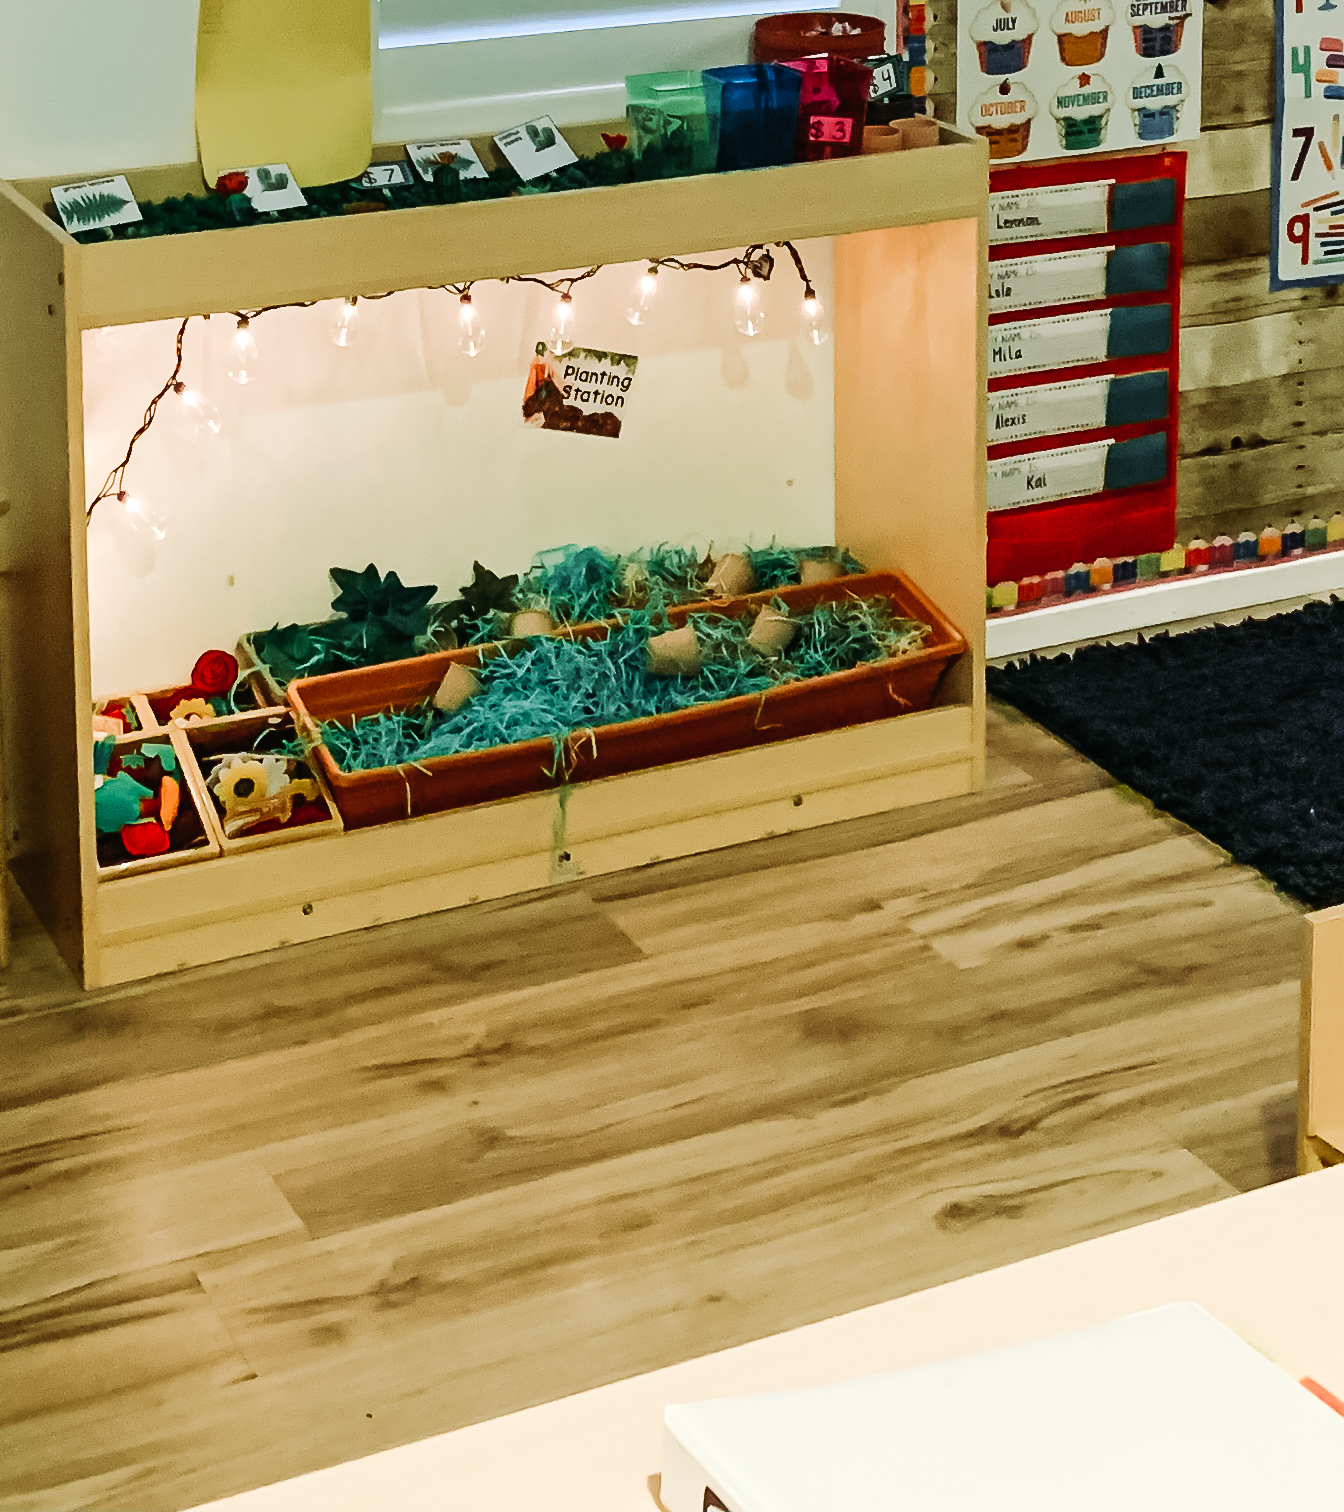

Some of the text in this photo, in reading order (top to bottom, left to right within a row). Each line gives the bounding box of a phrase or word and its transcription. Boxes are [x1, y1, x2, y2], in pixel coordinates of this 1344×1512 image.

[992, 16, 1018, 33] JULY
[1064, 7, 1102, 25] AUGUST
[1291, 44, 1312, 99] 4
[980, 81, 1183, 118] OCTOBER NOVEMBER DECEMBER
[1290, 125, 1316, 182] 7
[1286, 212, 1311, 266] 9
[563, 364, 633, 393] Planting
[561, 384, 625, 408] Station
[994, 413, 1027, 430] Alexis
